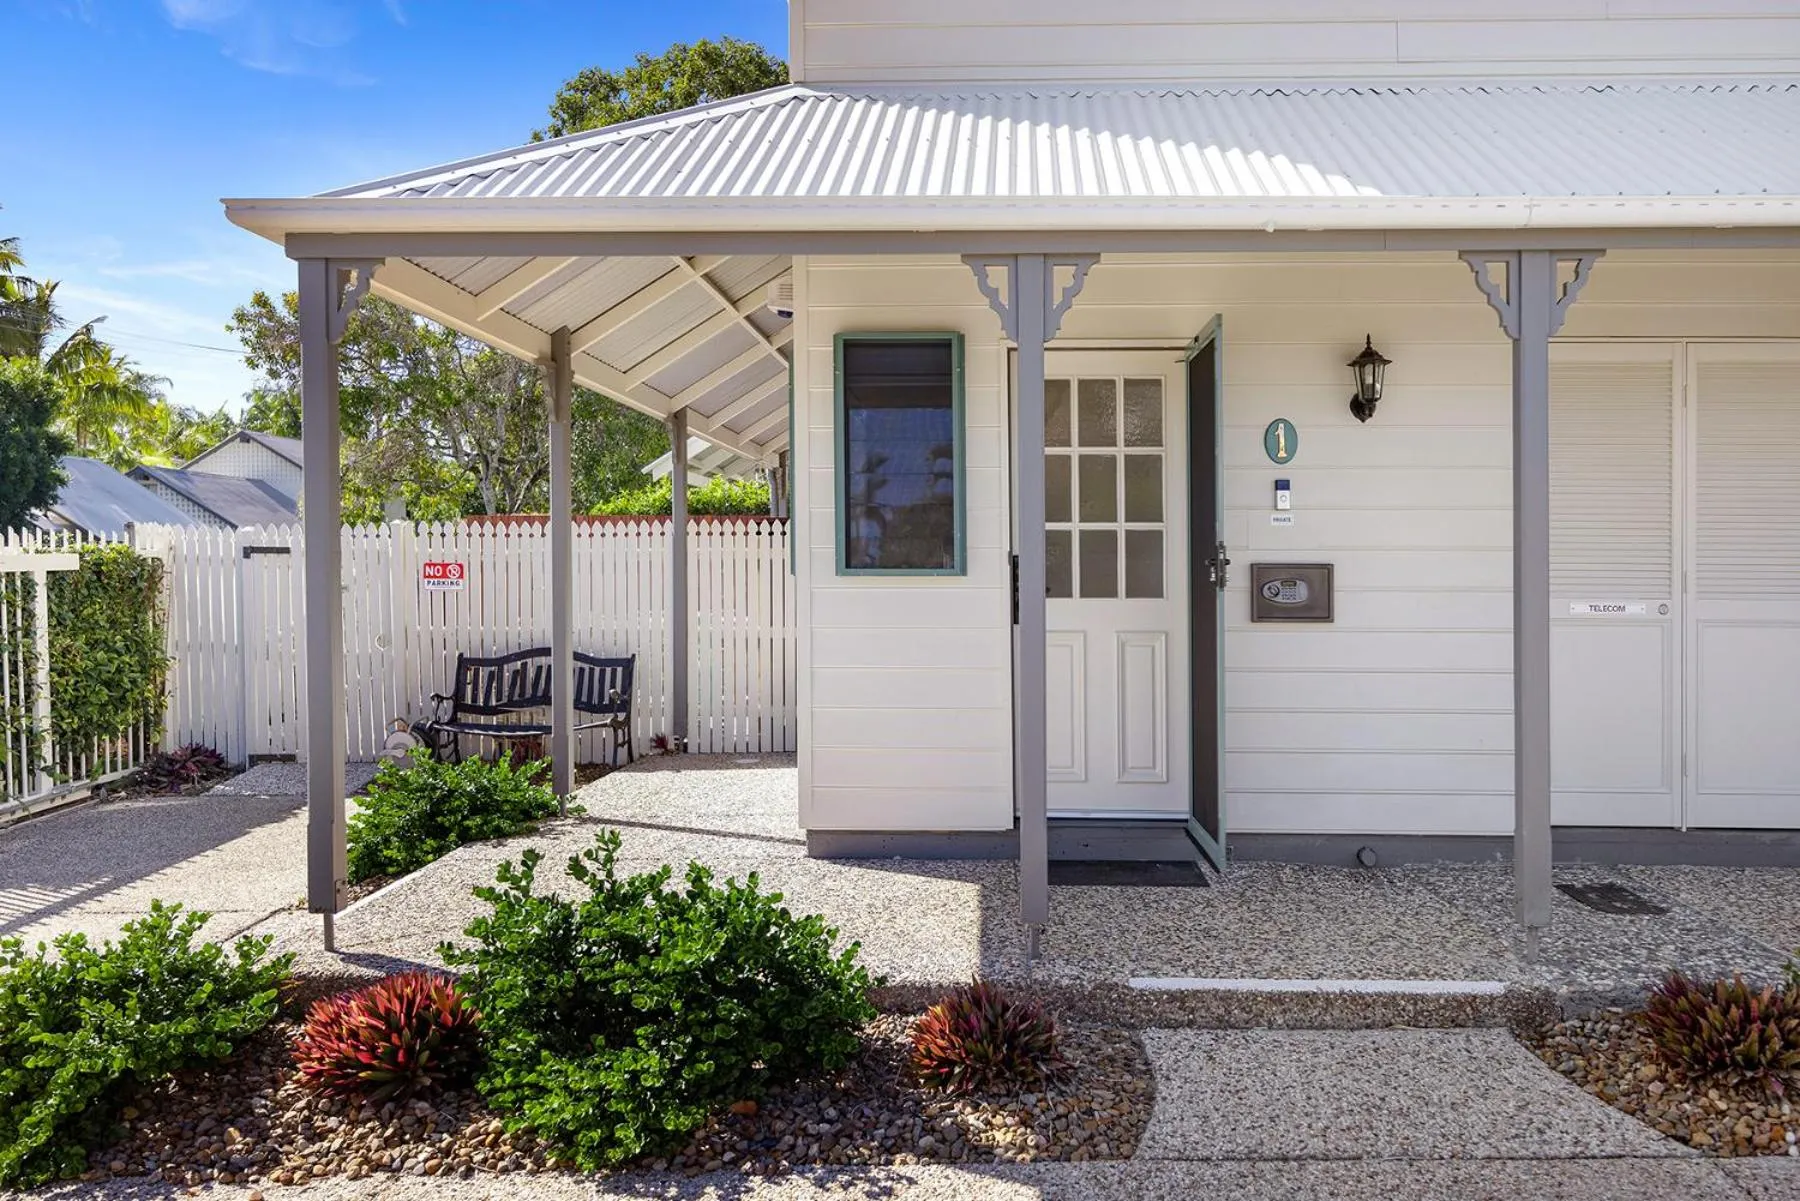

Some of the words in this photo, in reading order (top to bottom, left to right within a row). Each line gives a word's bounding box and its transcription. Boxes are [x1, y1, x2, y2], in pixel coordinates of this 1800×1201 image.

[1275, 423, 1288, 458] 1
[425, 565, 442, 577] NO
[1588, 604, 1626, 613] TELECOM
